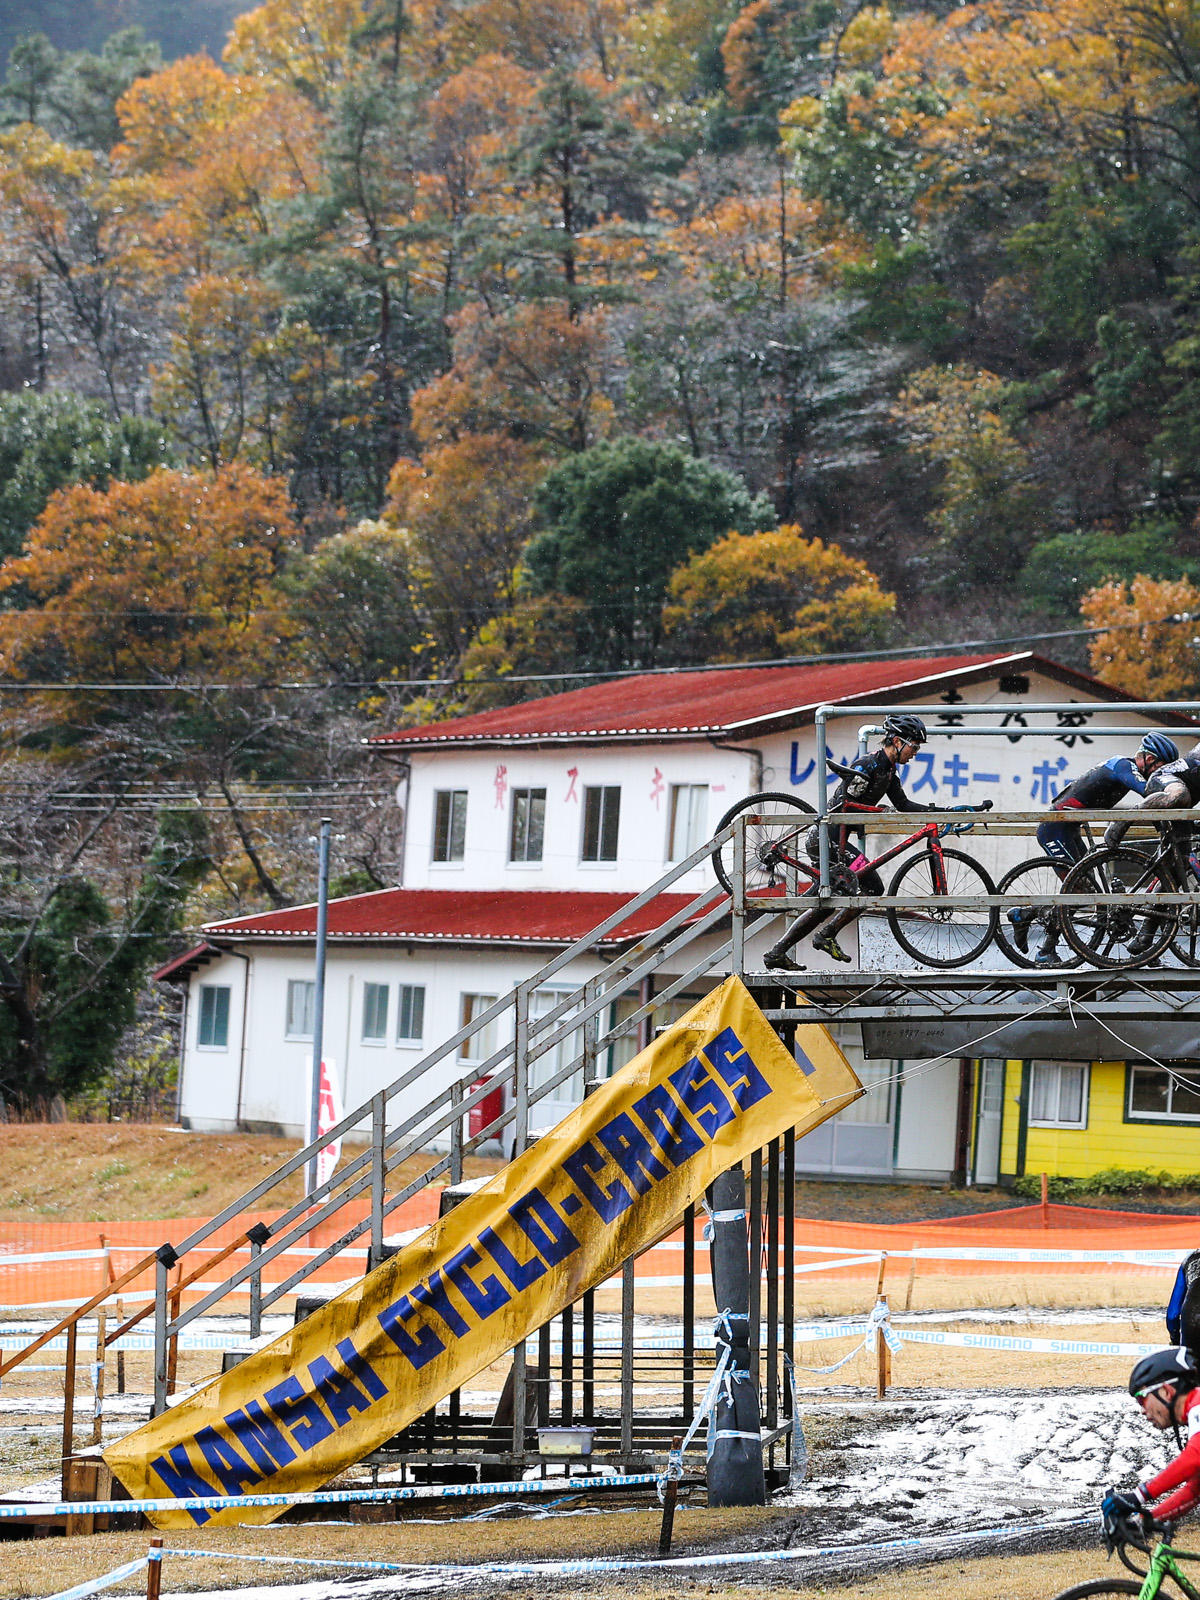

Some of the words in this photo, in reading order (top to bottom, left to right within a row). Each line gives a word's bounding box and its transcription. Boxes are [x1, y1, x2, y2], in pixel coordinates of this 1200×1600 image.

[151, 1337, 390, 1527] KANSAI
[376, 1026, 773, 1371] CYCLO-CROSS
[963, 1335, 1033, 1350] SHIMANO
[1050, 1341, 1121, 1354] SHIMANO
